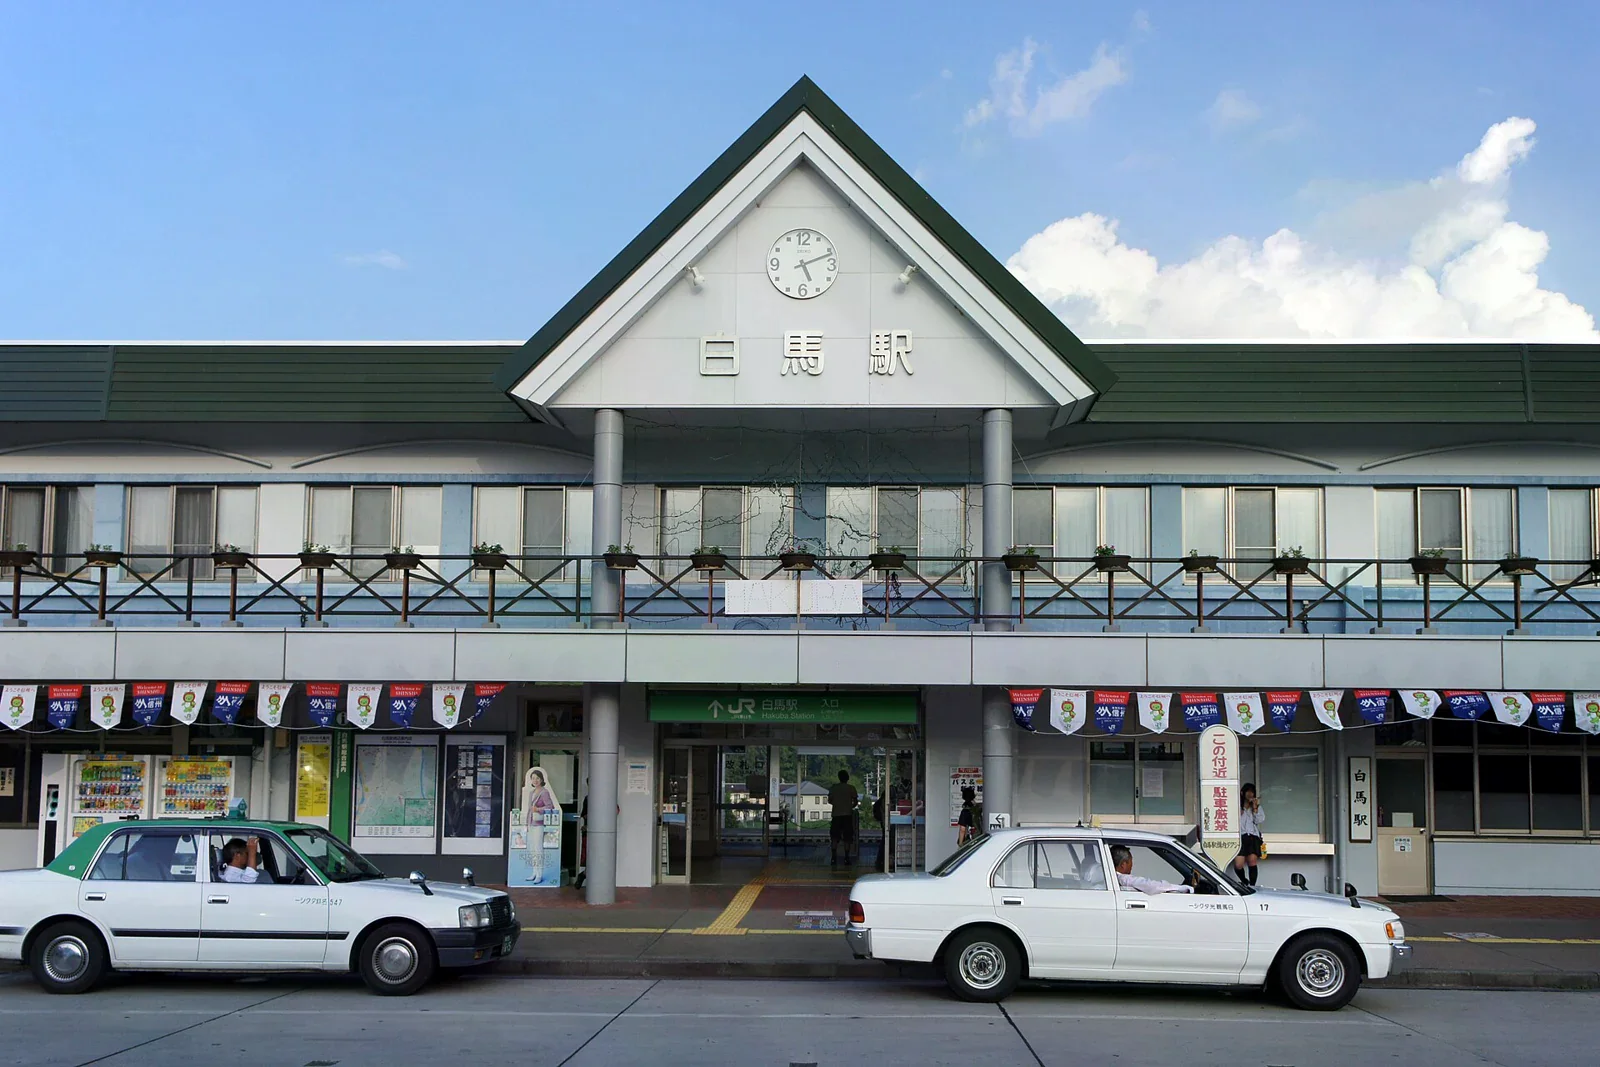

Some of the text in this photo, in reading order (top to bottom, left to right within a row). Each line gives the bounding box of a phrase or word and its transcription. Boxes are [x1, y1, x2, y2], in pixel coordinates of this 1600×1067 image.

[796, 232, 811, 246] 12
[770, 257, 836, 271] 9 3
[798, 283, 808, 298] 6
[699, 329, 914, 377] 白馬駅
[727, 582, 862, 613] HAKUBA
[147, 700, 162, 708] 信州
[728, 698, 756, 714] JR
[762, 699, 798, 711] 白馬駅
[821, 699, 839, 708] 入口
[1201, 706, 1218, 715] 信州
[1212, 733, 1228, 778] この付近
[1353, 769, 1369, 827] 白馬駅
[1213, 787, 1229, 832] 駐車厳禁
[330, 898, 343, 906] 547
[1259, 903, 1269, 911] 17
